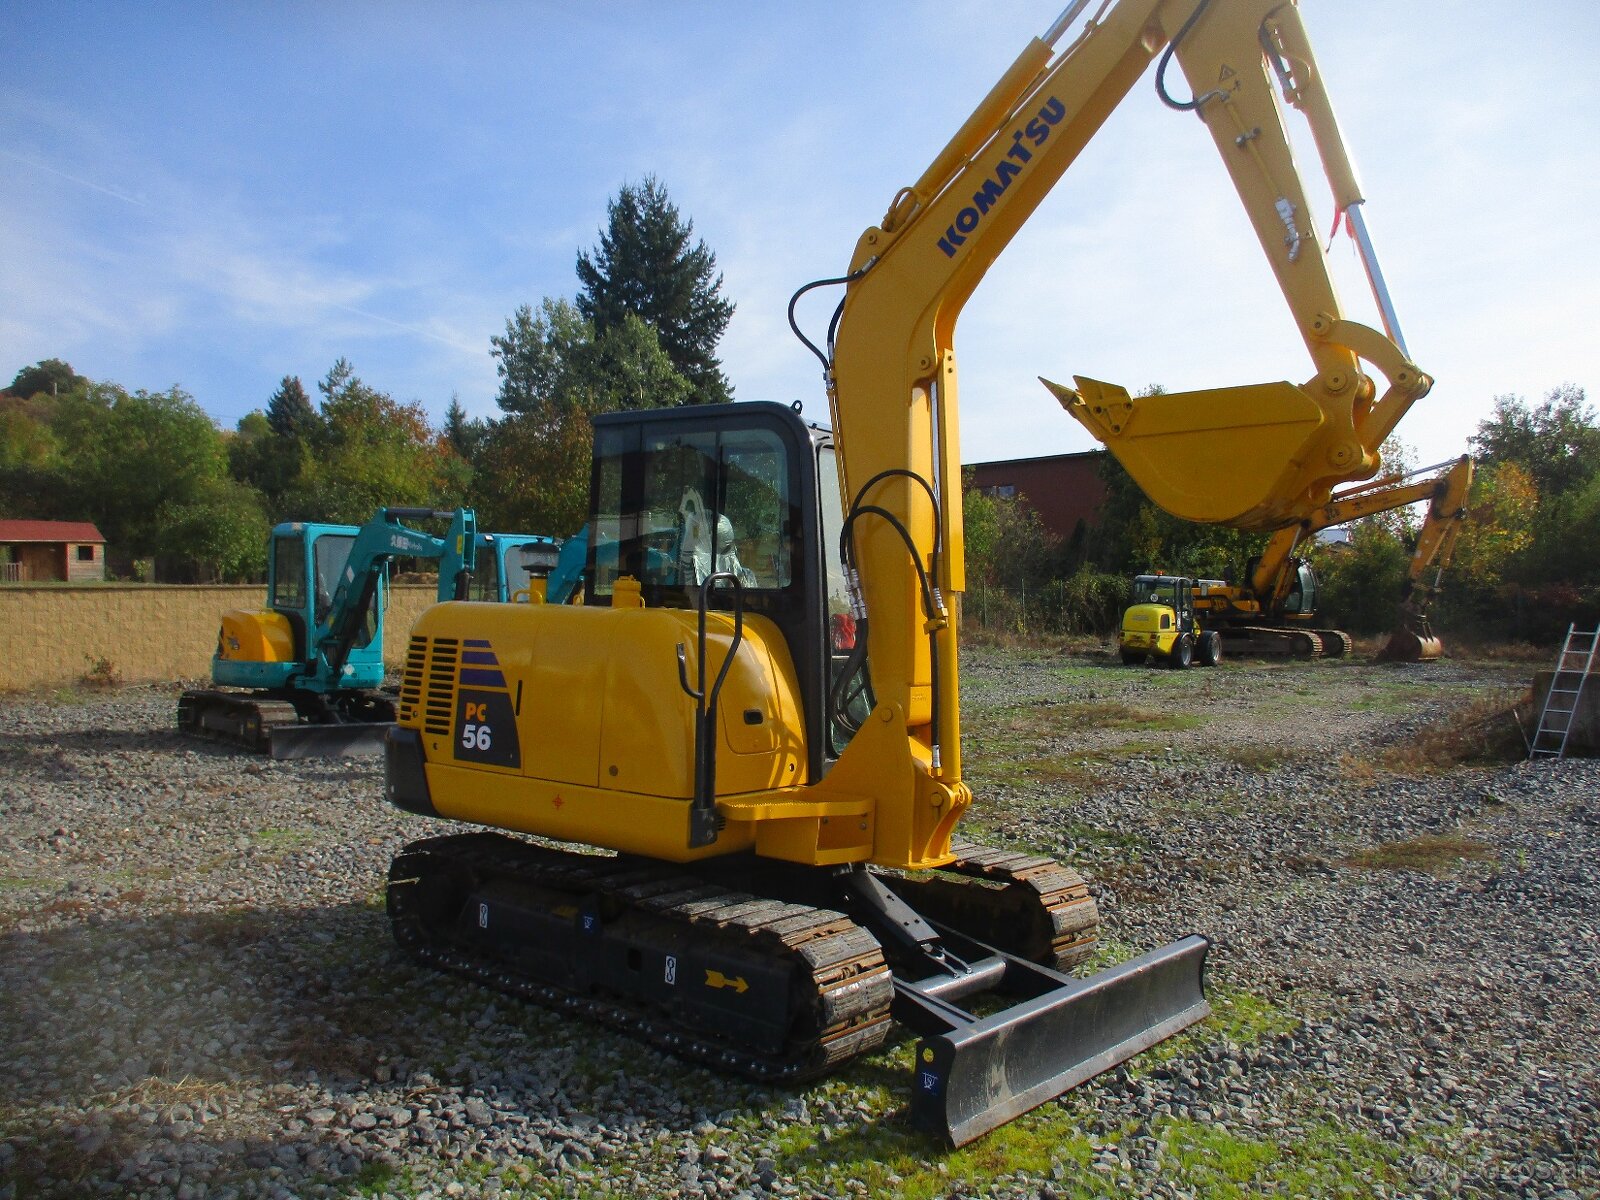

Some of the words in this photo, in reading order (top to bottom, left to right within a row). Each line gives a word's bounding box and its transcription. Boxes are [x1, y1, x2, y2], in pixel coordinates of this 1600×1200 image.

[937, 96, 1066, 258] KOMATSU
[465, 702, 487, 722] PC
[462, 724, 492, 751] 56
